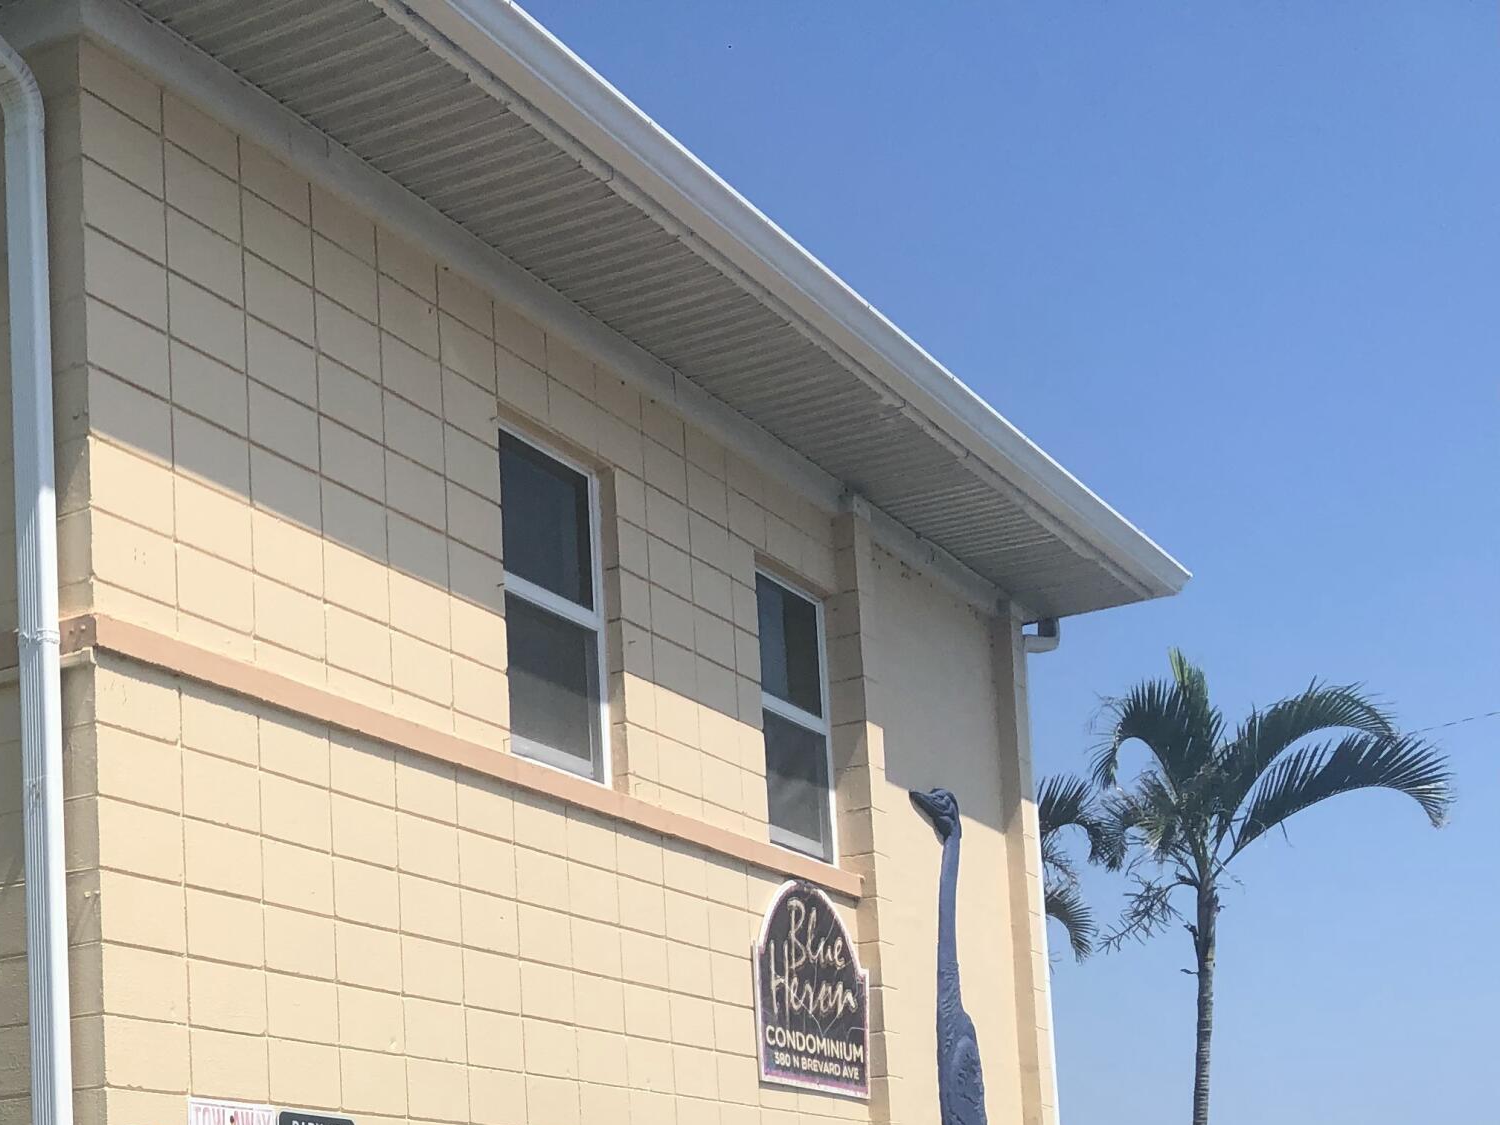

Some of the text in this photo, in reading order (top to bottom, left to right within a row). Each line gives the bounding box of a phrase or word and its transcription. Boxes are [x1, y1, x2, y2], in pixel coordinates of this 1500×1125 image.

[787, 896, 847, 970] Blue
[769, 939, 858, 1022] Heron
[765, 1025, 864, 1063] CONDOMINIUM
[793, 1056, 800, 1069] N
[801, 1057, 841, 1077] BREVARD
[842, 1063, 860, 1080] AVE
